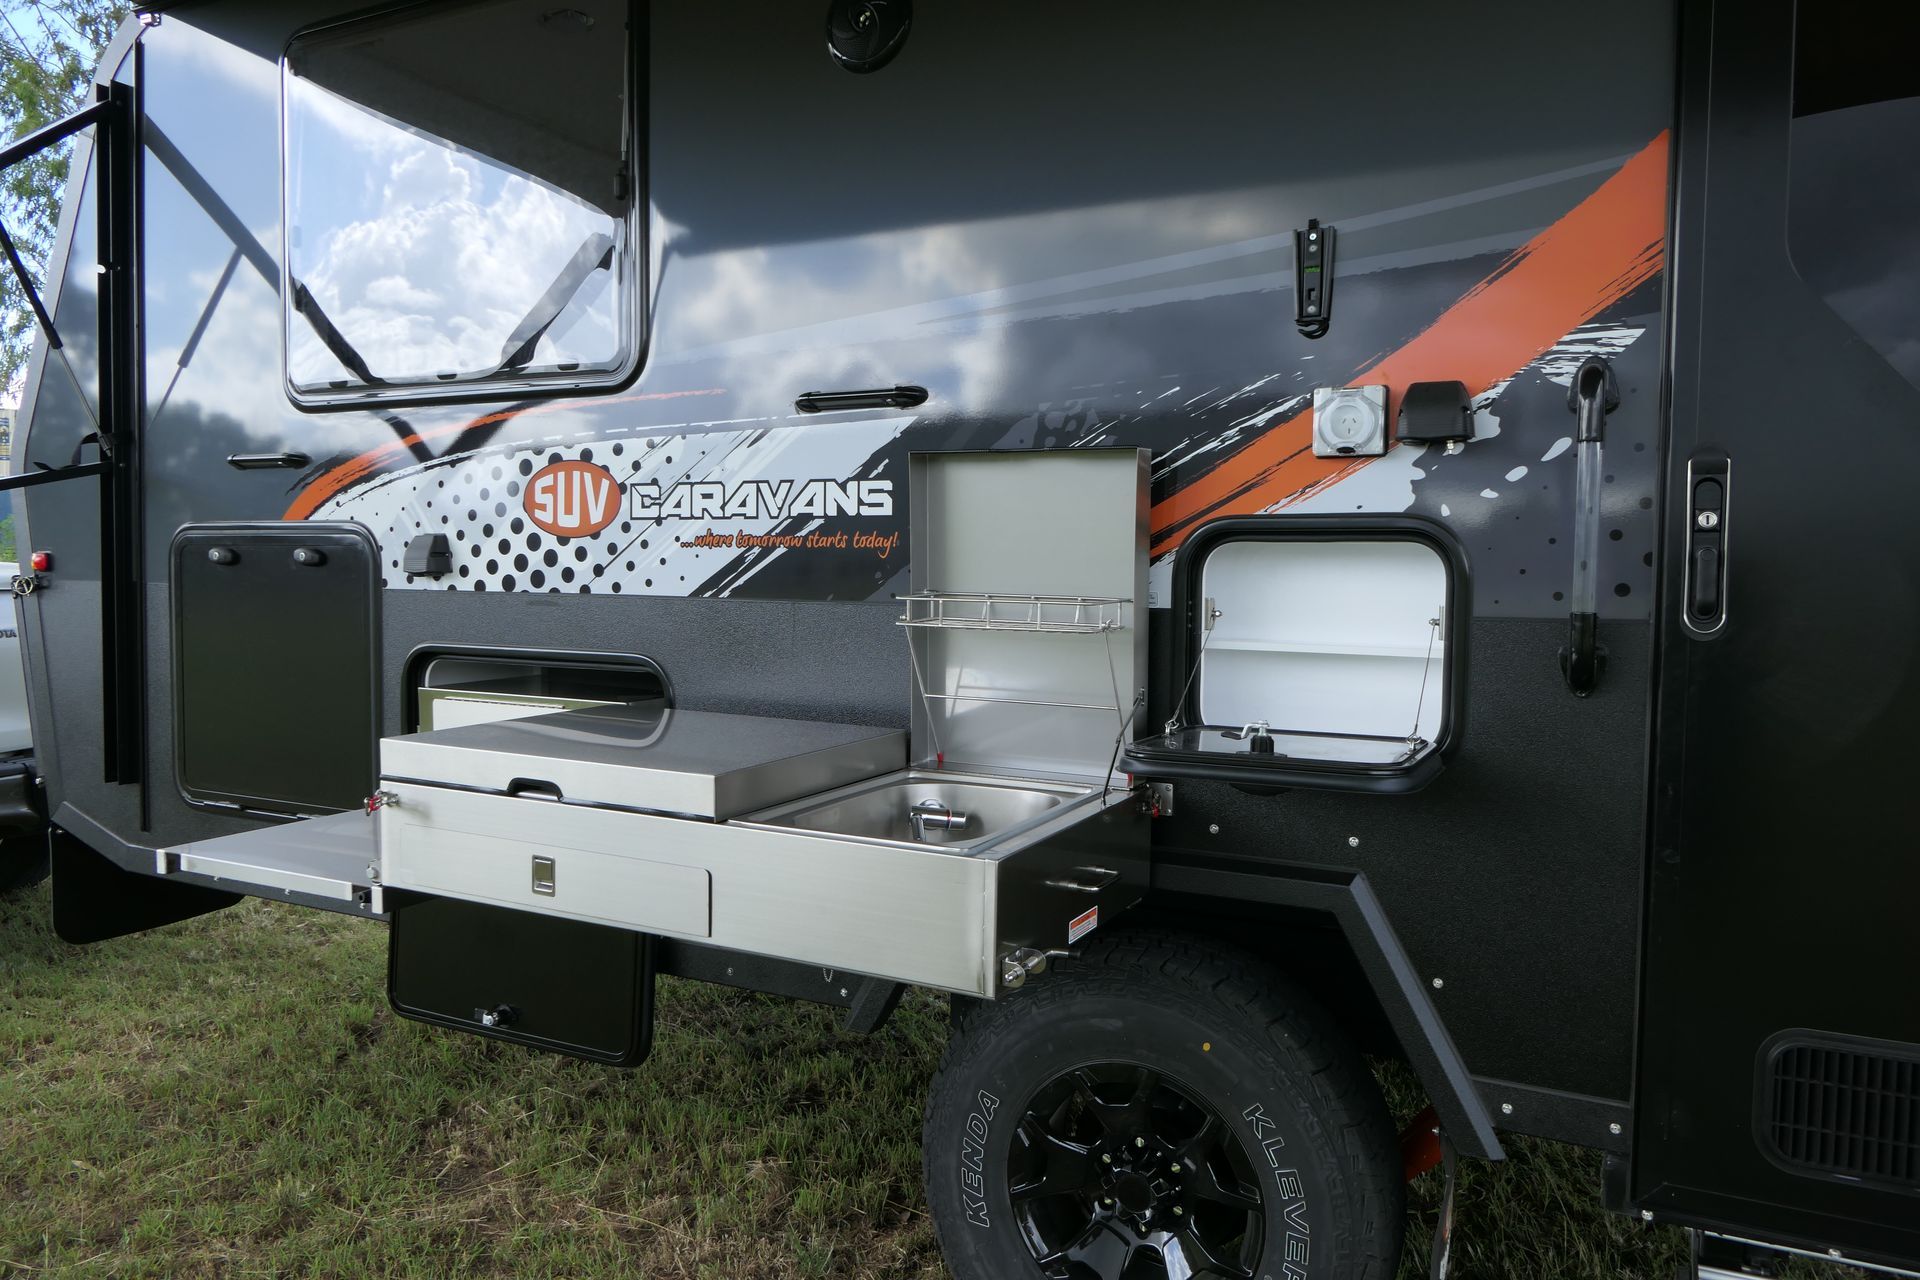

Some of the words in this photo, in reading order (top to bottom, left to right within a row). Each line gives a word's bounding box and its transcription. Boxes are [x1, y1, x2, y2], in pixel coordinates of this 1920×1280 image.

[534, 470, 610, 528] SUV
[630, 479, 893, 520] CARAVANS
[735, 529, 803, 549] tomorrow
[806, 531, 848, 548] starts
[853, 530, 899, 559] today!
[961, 1089, 1000, 1228] KENDA
